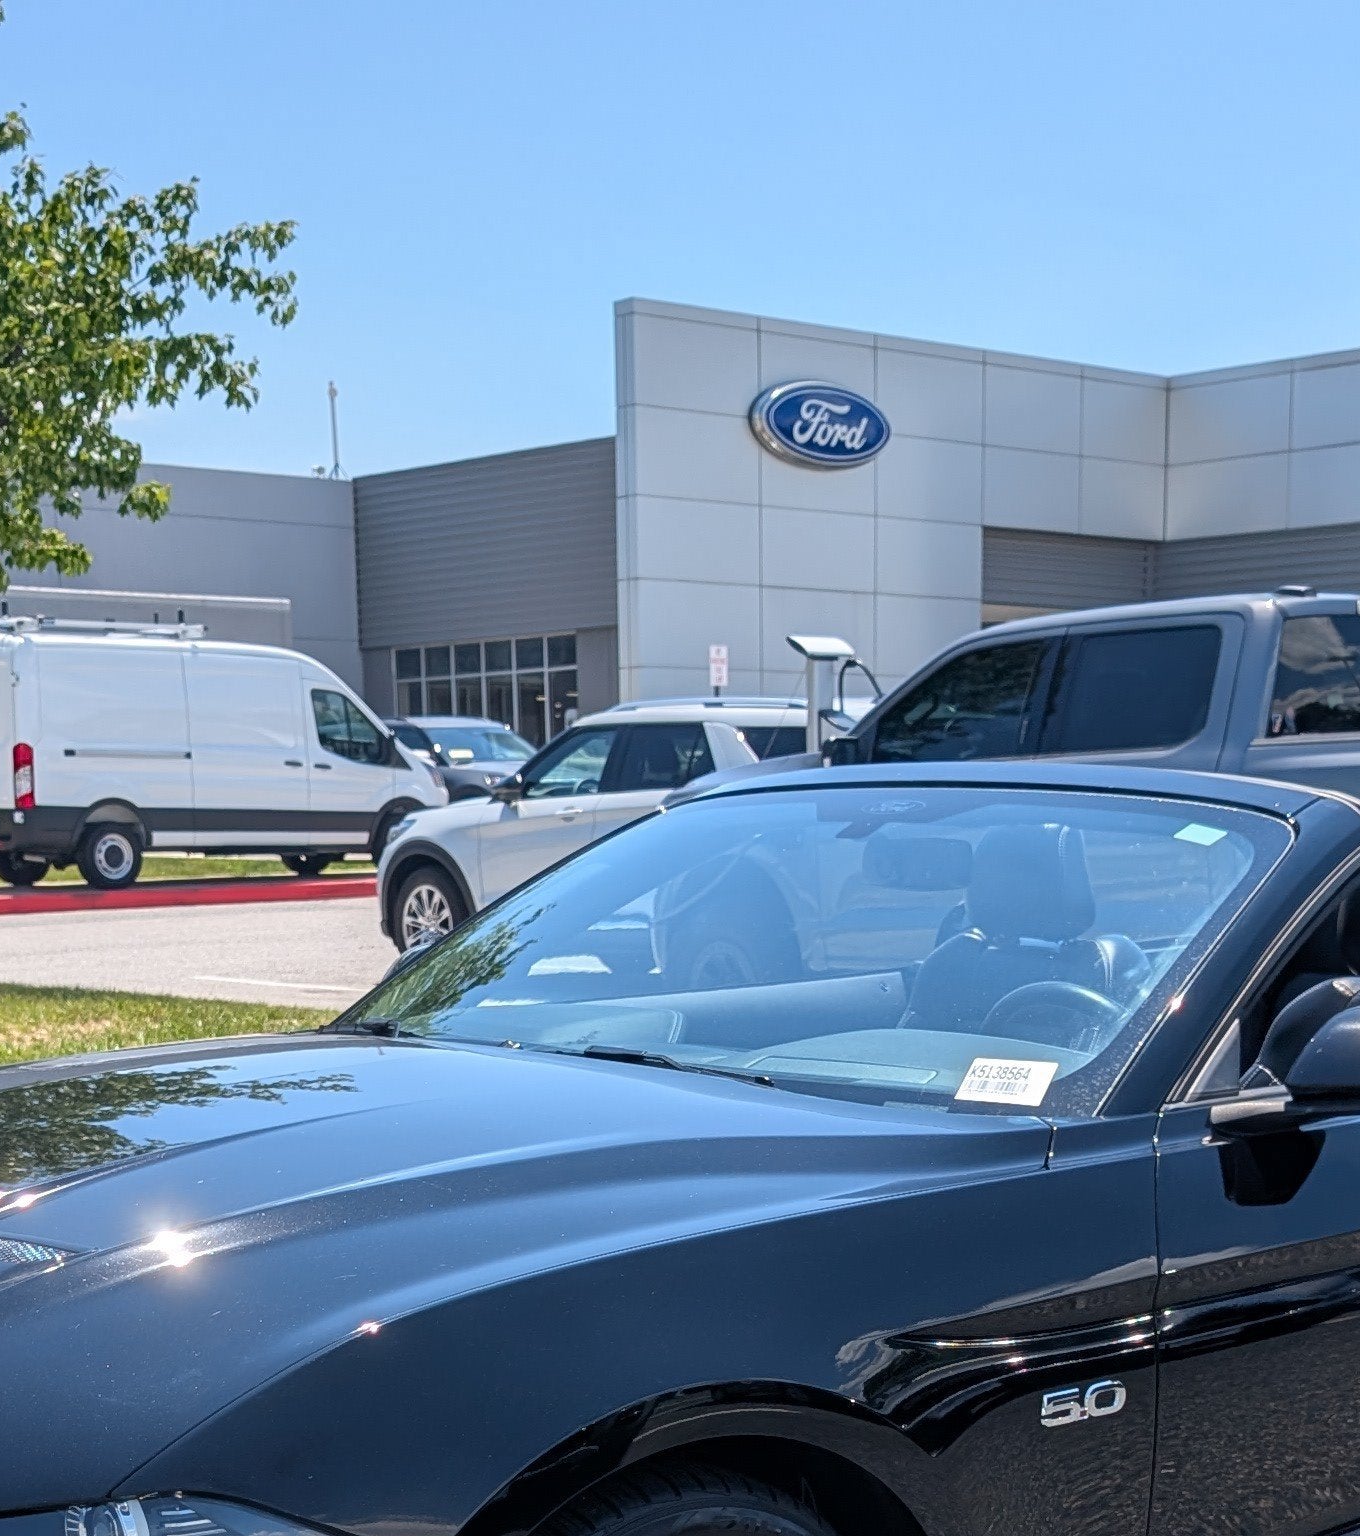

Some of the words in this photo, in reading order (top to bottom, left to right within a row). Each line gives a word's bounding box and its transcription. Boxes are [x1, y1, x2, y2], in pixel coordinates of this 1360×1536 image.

[792, 398, 869, 450] Ford
[969, 1064, 1032, 1081] K5138564
[1040, 1380, 1127, 1428] 5.0
